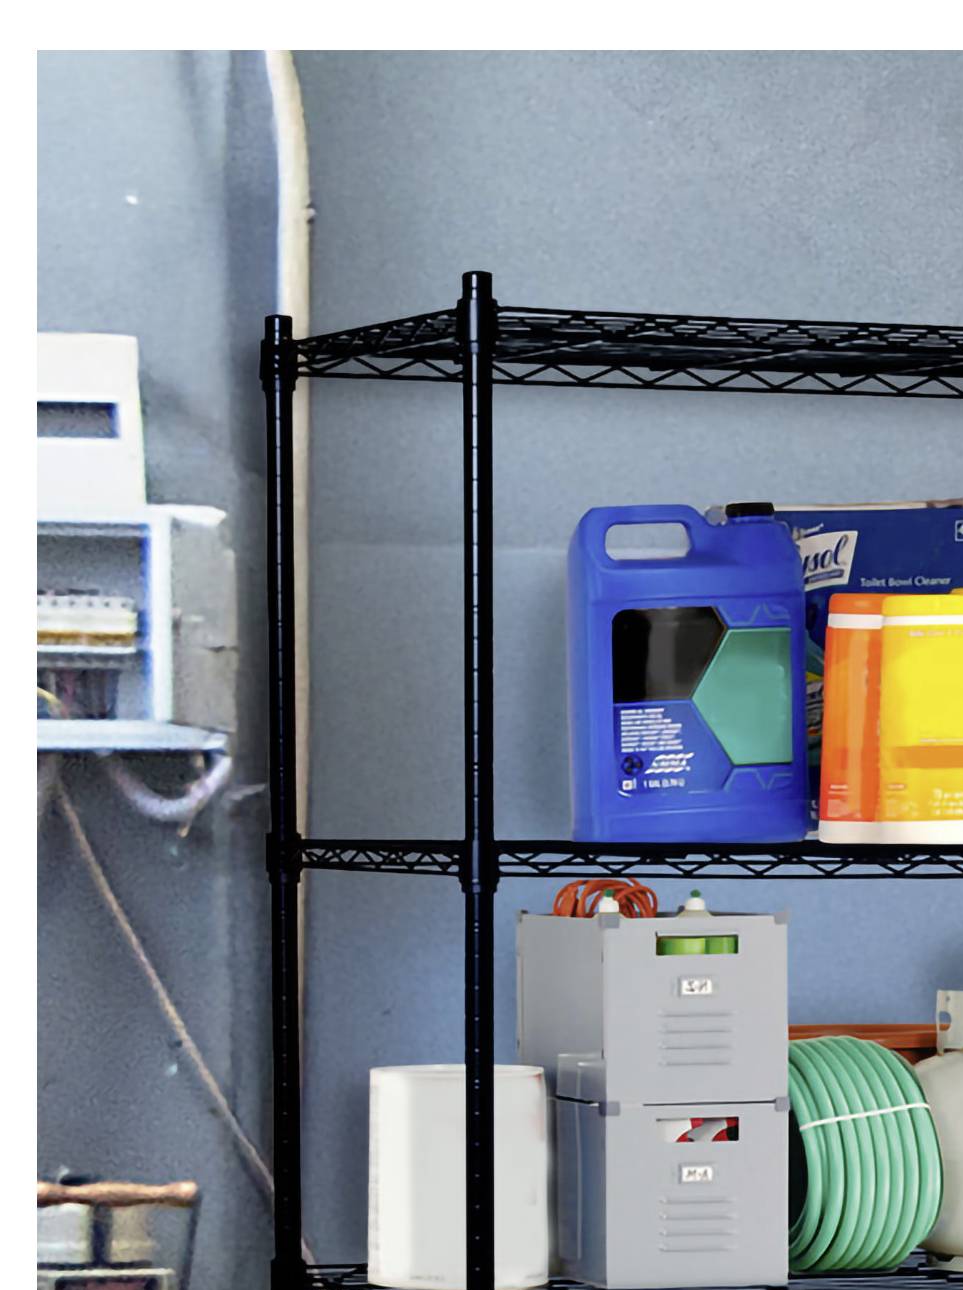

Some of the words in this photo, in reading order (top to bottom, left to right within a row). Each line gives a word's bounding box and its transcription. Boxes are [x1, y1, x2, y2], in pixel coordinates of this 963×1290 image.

[860, 577, 886, 587] Toilet
[888, 576, 913, 587] Bowl
[914, 575, 952, 587] Cleaner
